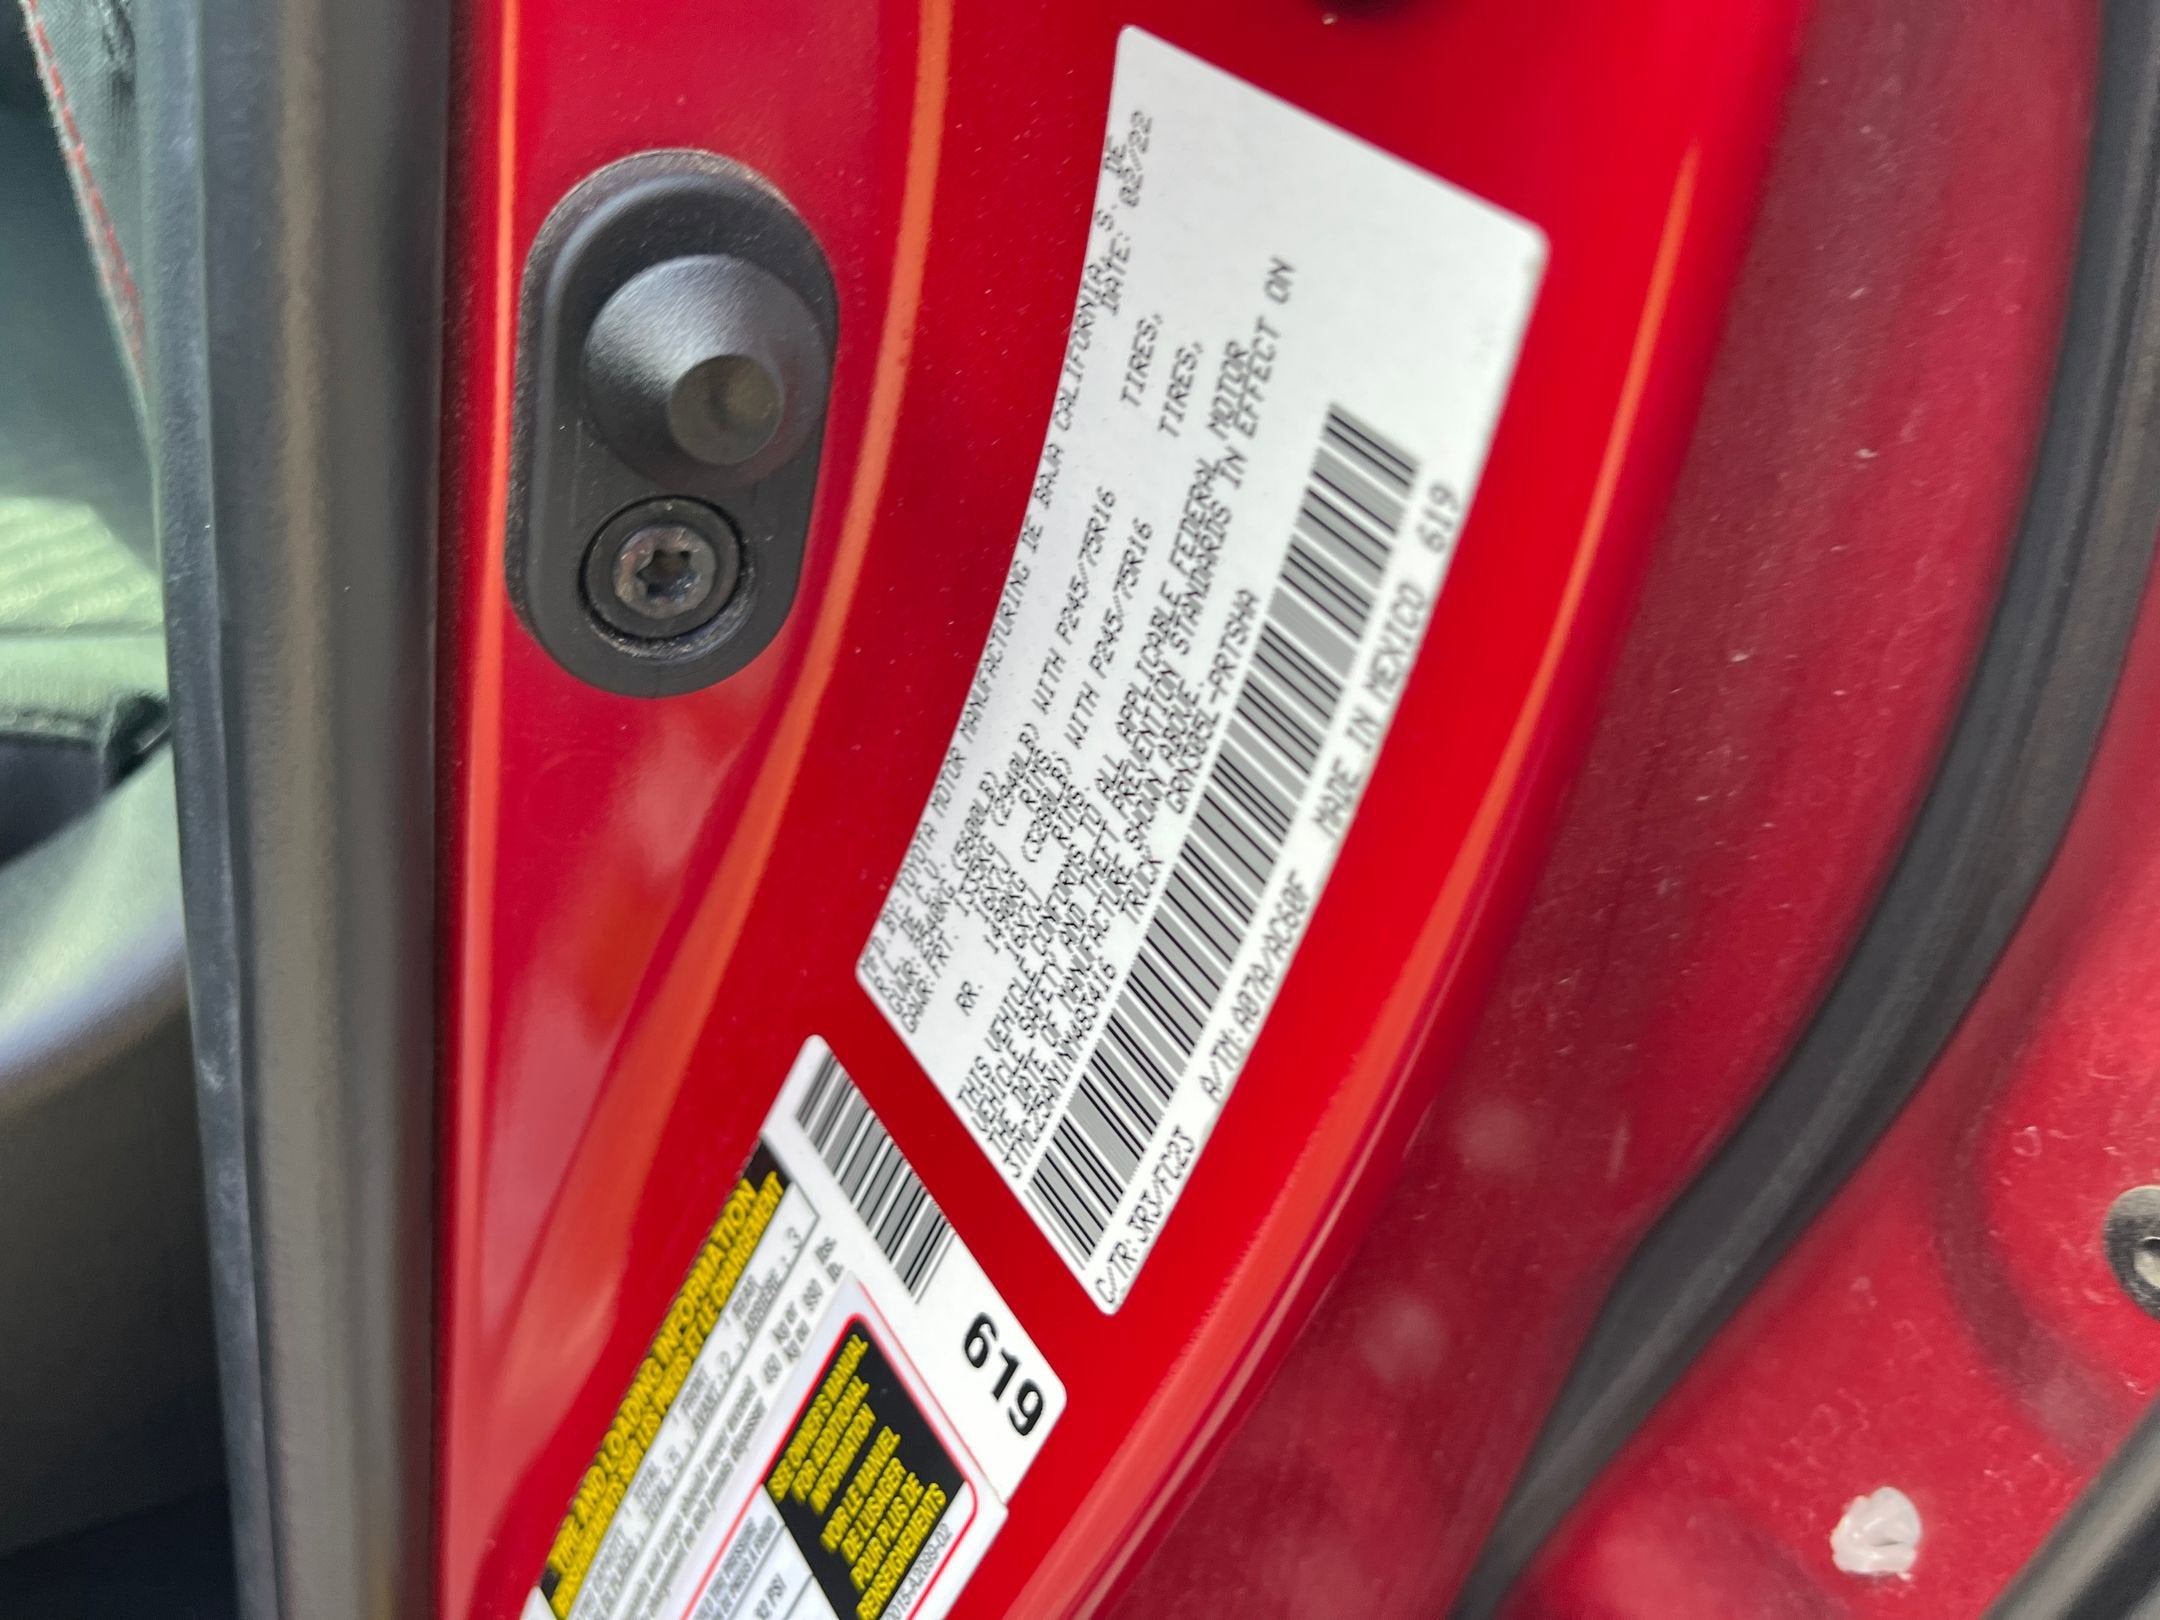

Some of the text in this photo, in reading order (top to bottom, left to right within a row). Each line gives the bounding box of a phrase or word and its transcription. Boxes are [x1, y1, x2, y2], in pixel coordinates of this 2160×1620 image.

[1099, 230, 1130, 315] DATE:
[1032, 648, 1067, 714] WITH
[1056, 485, 1116, 645] P245/75R16
[1120, 311, 1164, 406] TIRES,
[930, 746, 967, 818] MOTOR
[958, 559, 1031, 744] MANUFACTURING
[1021, 514, 1043, 554] DE
[1033, 440, 1065, 509] BAJA
[955, 980, 983, 1016] RR.
[1064, 680, 1100, 750] WITH
[1089, 516, 1153, 680] P245/75R16
[1158, 339, 1205, 437] TIRES,
[972, 255, 1295, 1133] VEHICLE SAFETY AND THEFT PREVENTION STANDARDS IN EFFECT ON
[1310, 757, 1362, 838] MADE
[1343, 705, 1381, 754] IN
[1363, 580, 1429, 703] MEXICO
[1414, 479, 1462, 555] 619
[957, 338, 1249, 1112] THIS VEHICLE CONFORMS TO ALL APPLICABLE FEDERAL MOTOR
[1120, 845, 1162, 924] TRUCK
[1165, 587, 1260, 814] GRN305L-PRTSHA
[986, 679, 1205, 1155] THE DATE OF MANUFACTURE SHOWN ABOVE.
[708, 1171, 784, 1309] CHARGEMENT
[548, 1513, 584, 1573] TIRE
[572, 1462, 607, 1526] AND
[595, 1355, 666, 1474] LOADING
[652, 1177, 758, 1364] INFORMATION
[681, 1322, 706, 1359] ET
[693, 1297, 720, 1336] LE
[963, 1311, 1044, 1436] 619
[766, 1333, 870, 1502] SEE OWNER'S MANUAL
[790, 1374, 870, 1503] FOR ADDITIONAL
[808, 1402, 877, 1515] INFORMATION
[821, 1425, 902, 1552] VOIR LE MANUEL
[841, 1527, 866, 1563] DE
[850, 1471, 926, 1592] POUR PLUS DE
[858, 1481, 949, 1620] RENSEIGNEMENTS
